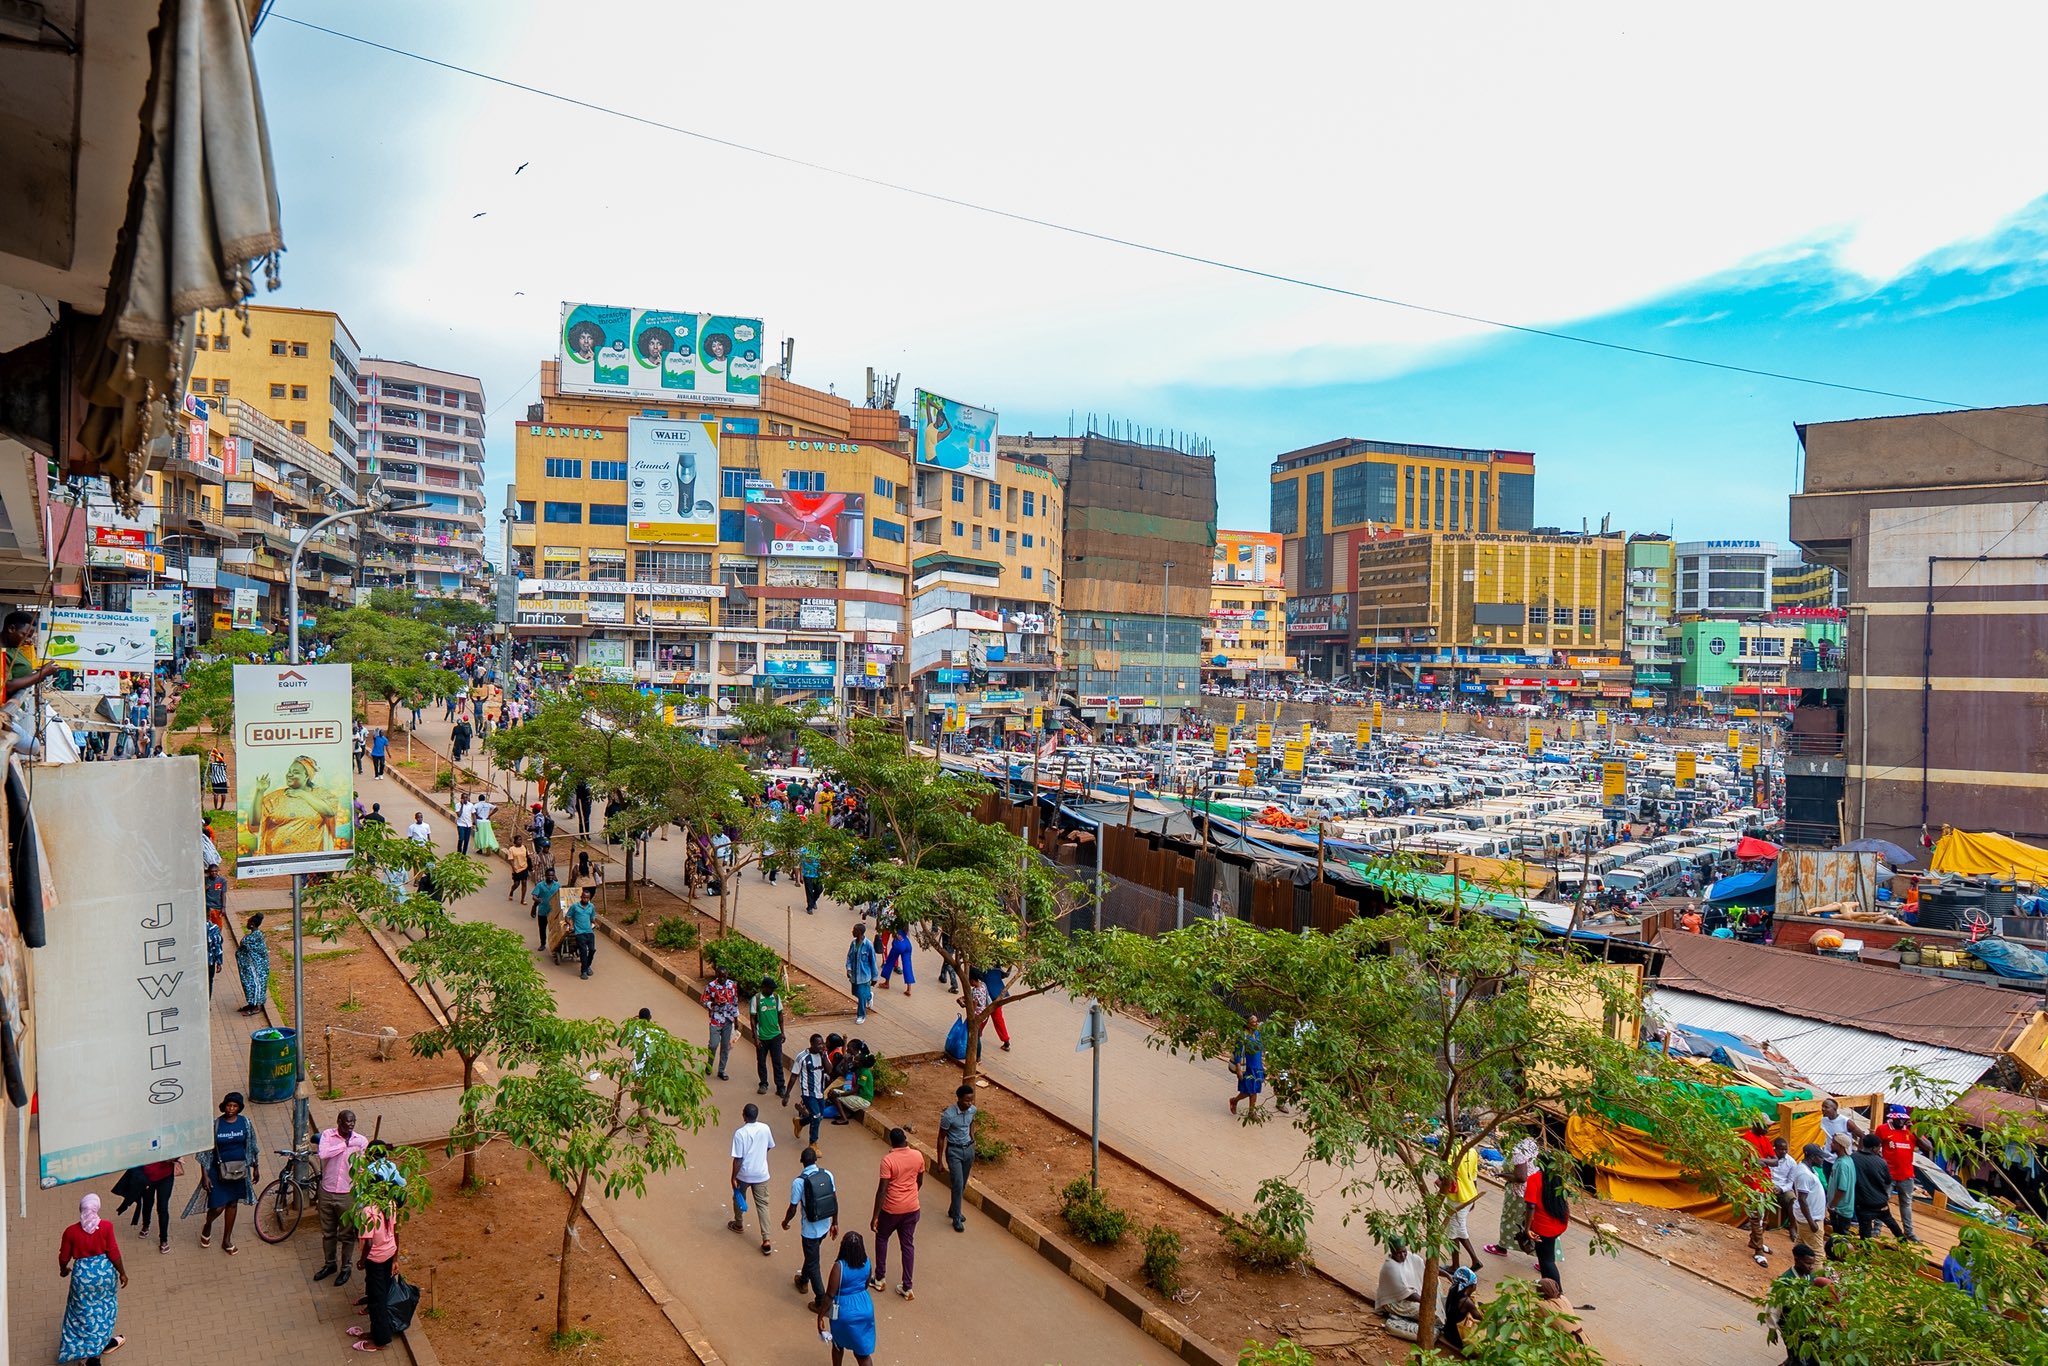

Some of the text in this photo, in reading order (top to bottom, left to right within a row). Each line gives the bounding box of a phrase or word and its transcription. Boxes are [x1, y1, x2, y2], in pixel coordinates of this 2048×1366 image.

[677, 393, 735, 403] AVAILABLE COUNTRYWIDE
[530, 425, 604, 440] HANIFA
[655, 431, 684, 440] WAHL
[787, 440, 859, 453] TOWERS
[631, 460, 670, 470] Launch
[1015, 463, 1048, 479] HANIFA
[1442, 533, 1470, 541] ROYAL
[1474, 533, 1512, 542] COMPLEX
[1513, 534, 1539, 543] HOTEL
[1707, 540, 1761, 548] NAMAYIBA
[631, 585, 644, 593] F33
[520, 600, 589, 611] MONDS HOTEL
[50, 610, 150, 623] MARTINEZ SUNGLASSES
[522, 612, 567, 624] Infinix
[253, 727, 335, 741] EQUI-LIFE
[137, 902, 184, 1105] JEWELS
